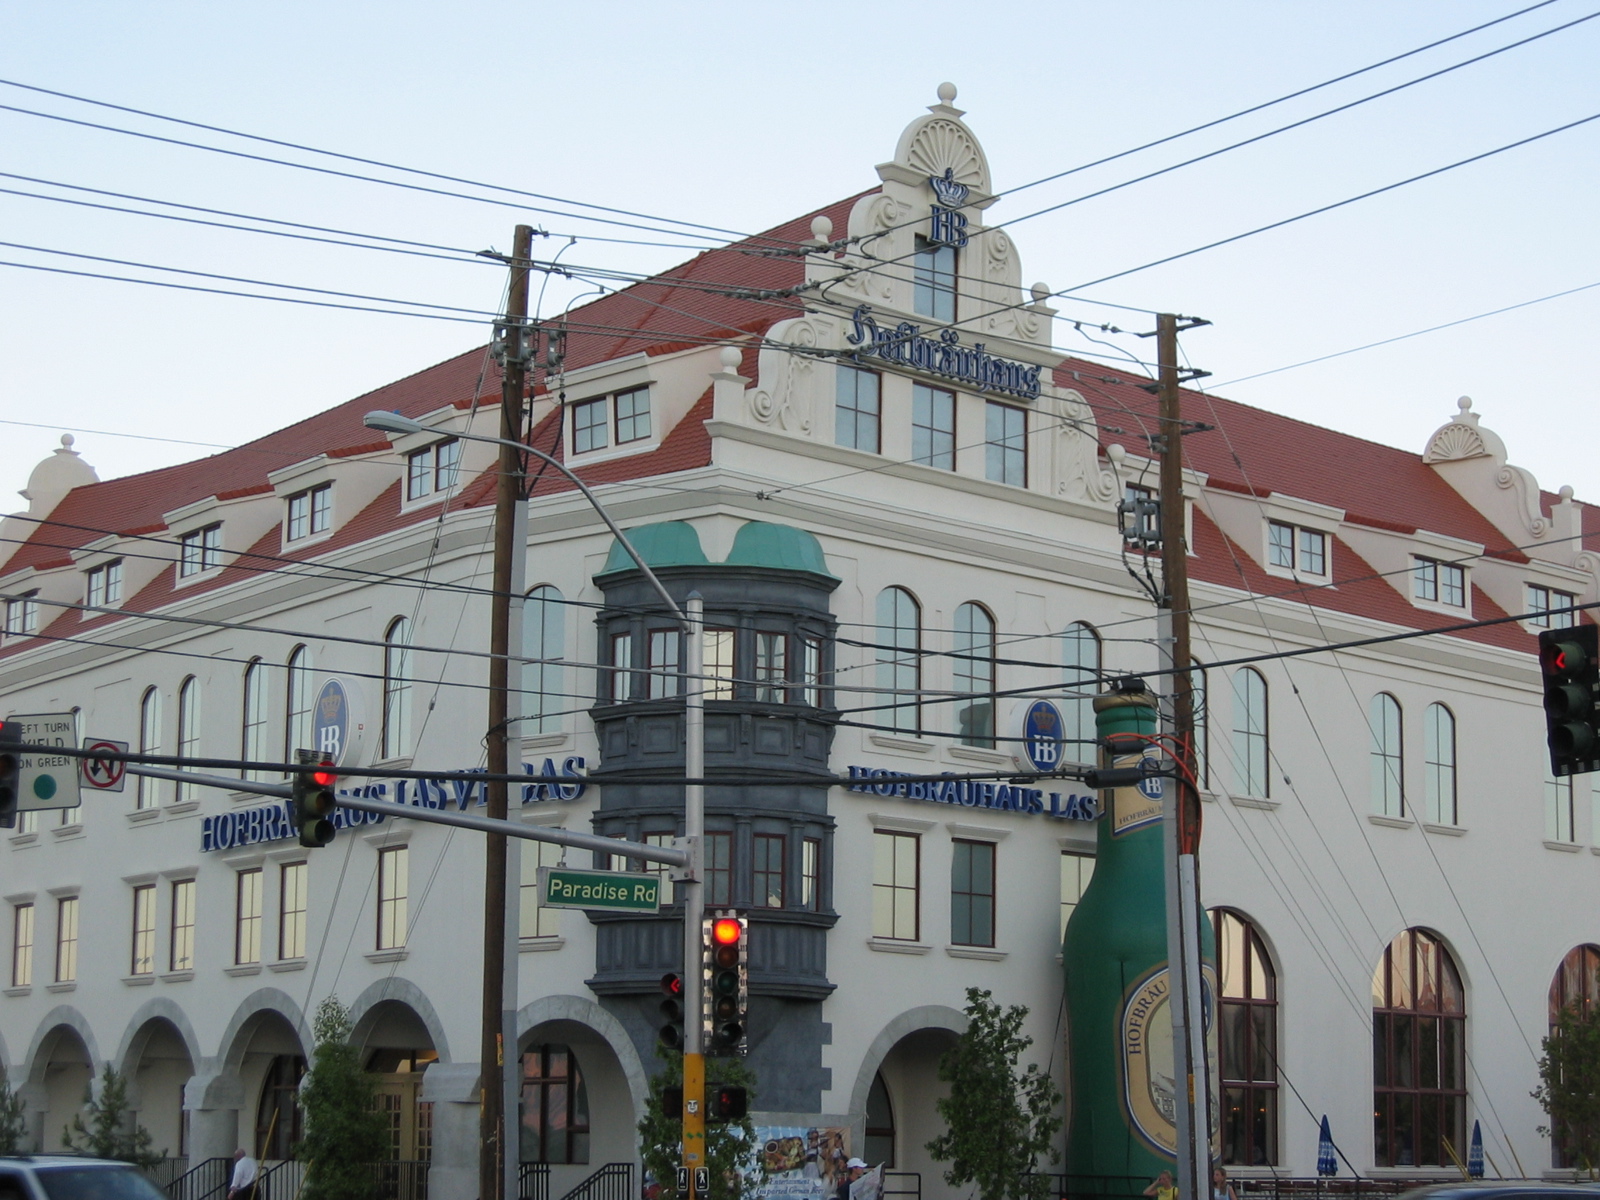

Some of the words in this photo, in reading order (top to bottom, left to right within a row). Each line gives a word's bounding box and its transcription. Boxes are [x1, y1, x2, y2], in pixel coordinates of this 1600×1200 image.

[930, 204, 968, 248] HB
[20, 724, 38, 734] EFT
[44, 722, 70, 733] TURN
[320, 725, 340, 757] HB
[20, 759, 32, 769] ON
[38, 757, 70, 768] GREEN
[1033, 734, 1057, 763] HB
[1145, 777, 1162, 794] HB
[1049, 792, 1097, 822] LAS
[550, 879, 628, 900] Paradise
[633, 885, 656, 902] Rd
[1128, 980, 1167, 1055] HOFBRÄU
